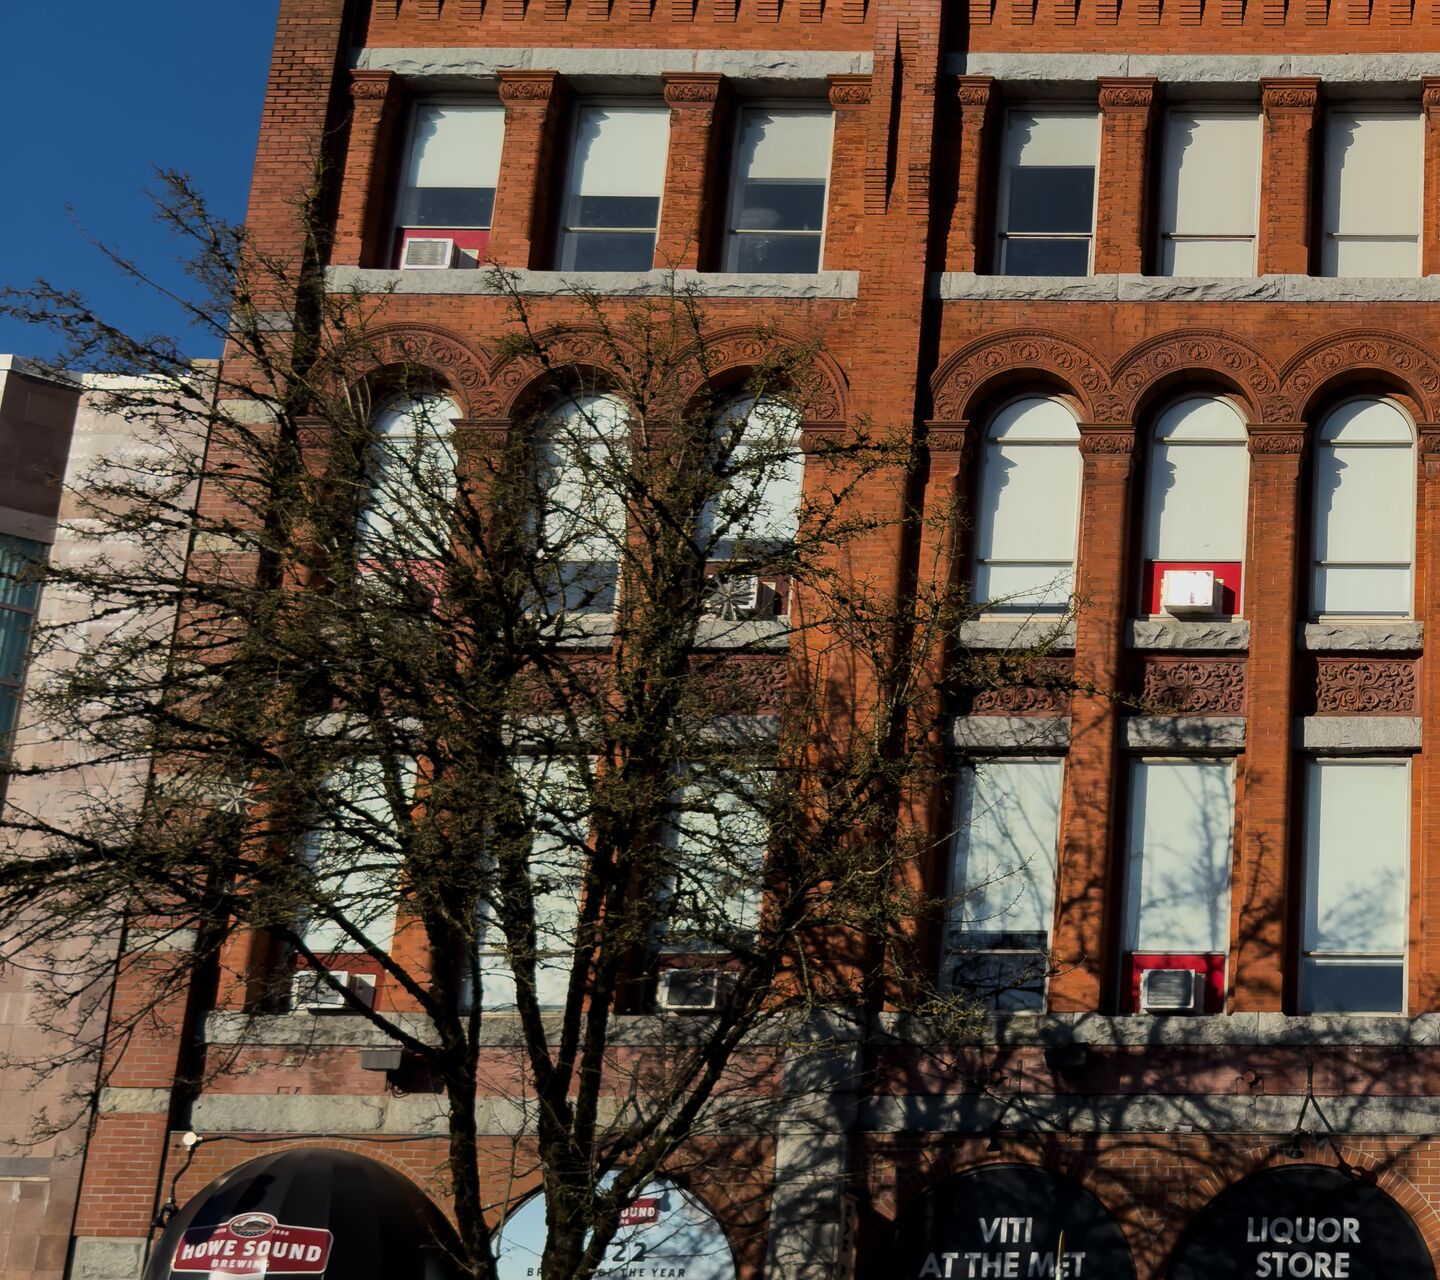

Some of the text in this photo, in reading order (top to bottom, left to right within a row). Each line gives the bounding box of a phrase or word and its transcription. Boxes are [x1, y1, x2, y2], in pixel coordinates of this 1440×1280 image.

[621, 1207, 656, 1218] OUND
[979, 1217, 1033, 1244] VITI
[1246, 1217, 1361, 1245] LIQUOR
[181, 1239, 322, 1263] HOWE SOUND
[210, 1258, 270, 1269] BREWING
[652, 1268, 686, 1278] YEAR
[918, 1251, 1086, 1279] AT THE MET
[1255, 1251, 1350, 1279] STORE
